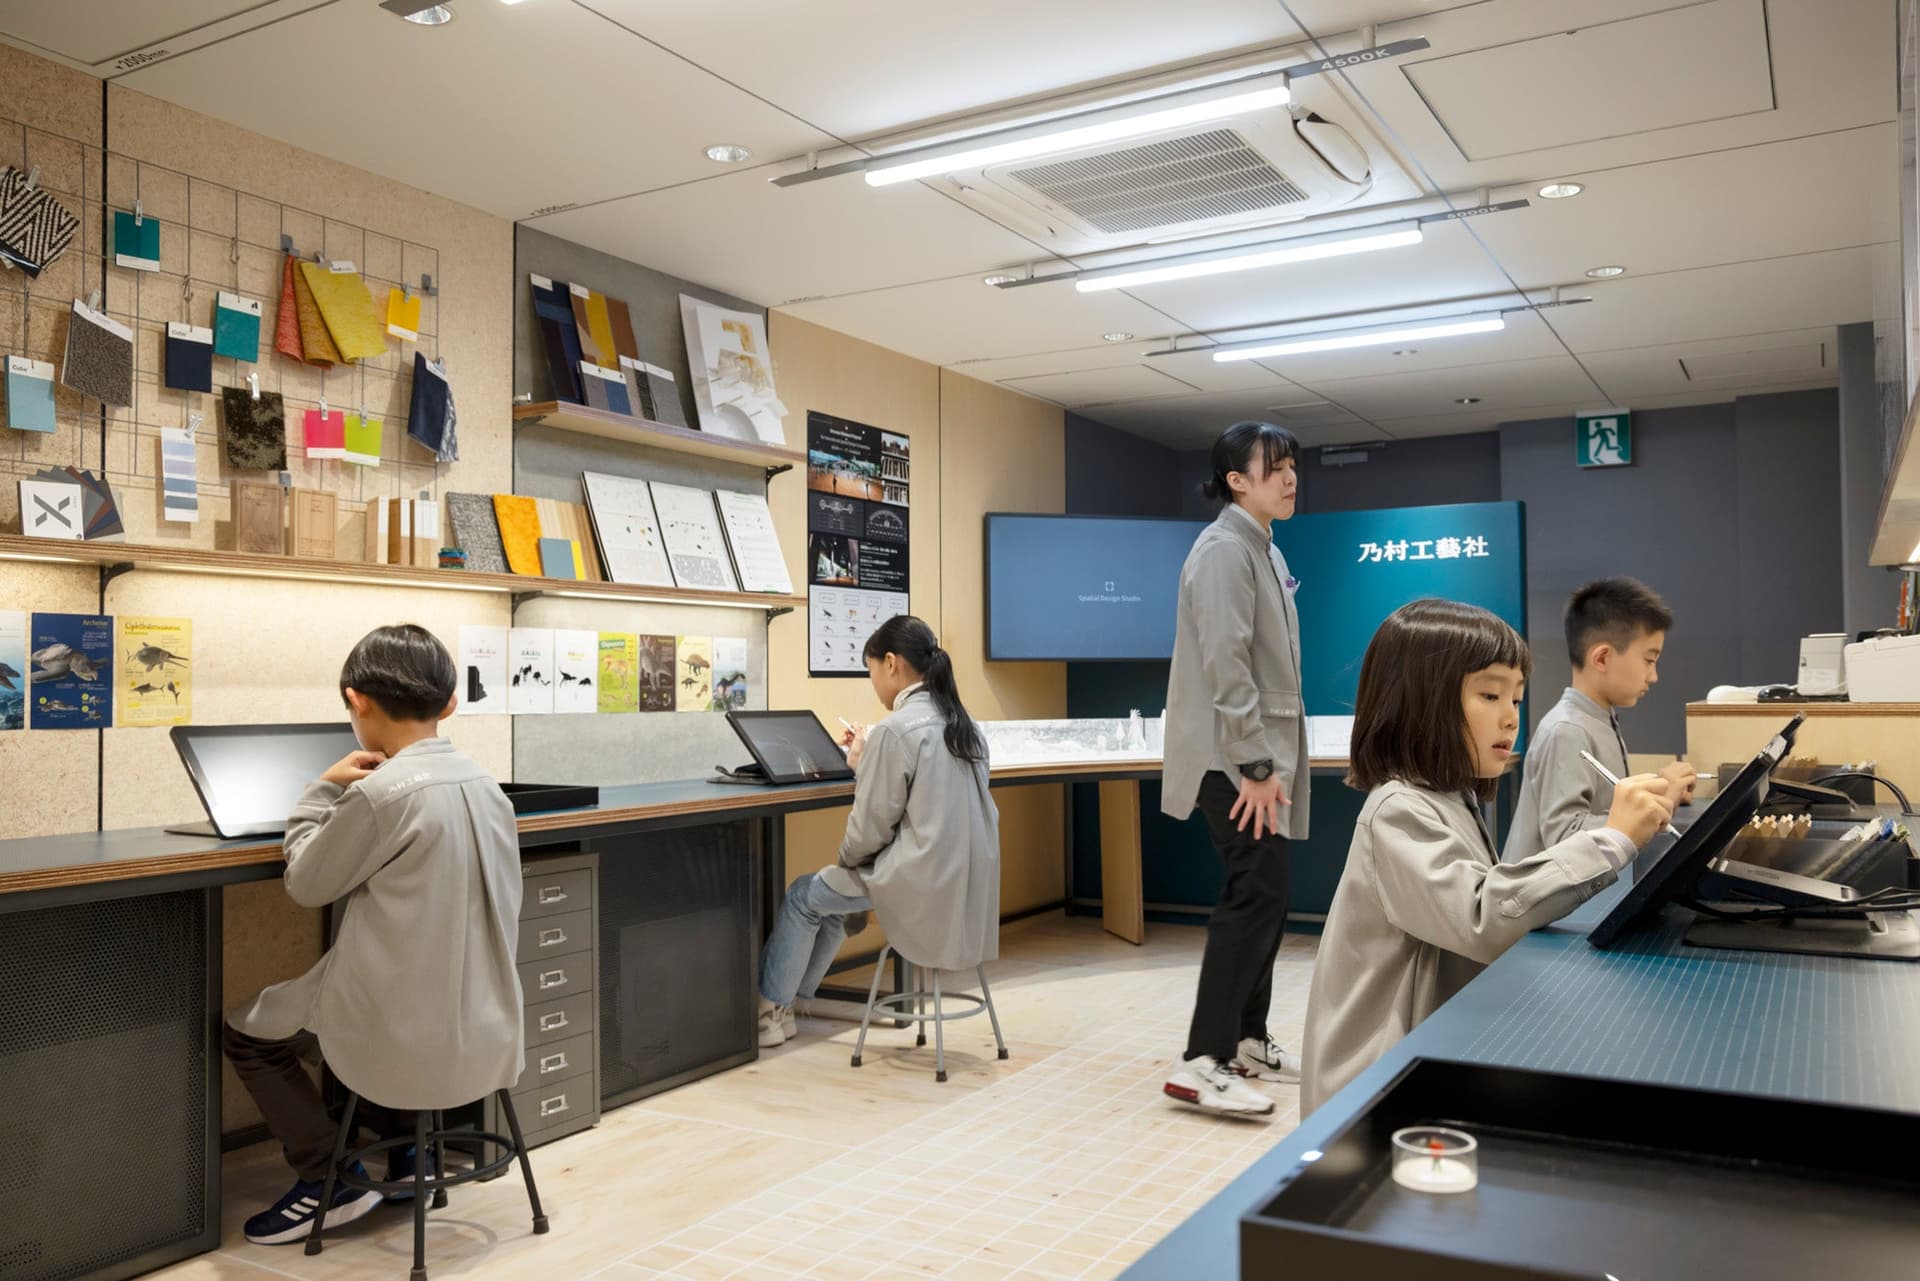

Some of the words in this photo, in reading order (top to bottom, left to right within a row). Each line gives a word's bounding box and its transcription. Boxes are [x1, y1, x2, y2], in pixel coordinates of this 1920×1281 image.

[1320, 47, 1391, 70] 4500K
[1357, 535, 1490, 563] 乃村工藝社
